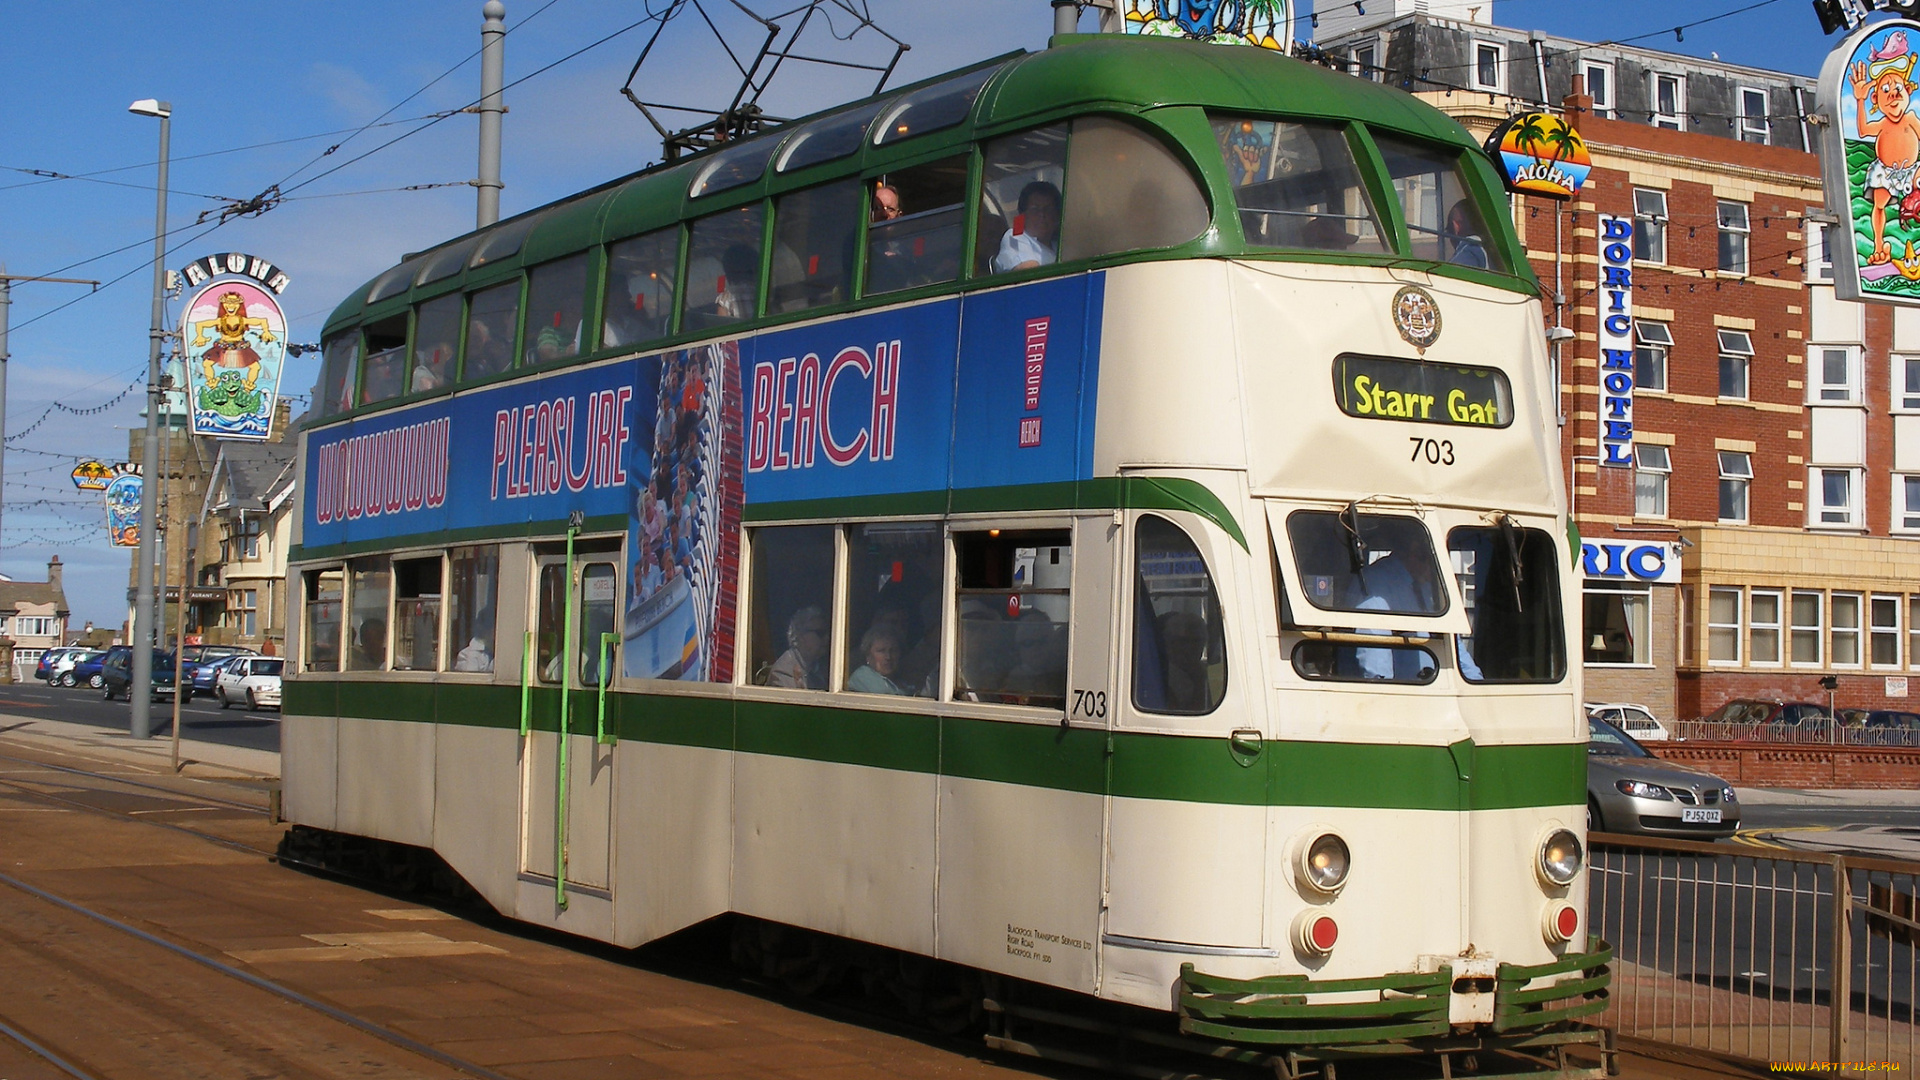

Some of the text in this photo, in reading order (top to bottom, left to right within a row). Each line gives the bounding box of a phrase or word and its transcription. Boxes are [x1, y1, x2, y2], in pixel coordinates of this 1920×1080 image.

[1514, 163, 1576, 193] ALOHA
[183, 252, 291, 296] ALOHA
[1602, 218, 1633, 338] DORIC
[1027, 321, 1049, 405] PLEASURE
[747, 339, 902, 473] BEACH
[1353, 374, 1435, 420] Starr
[1602, 348, 1633, 466] HOTEL
[490, 386, 634, 501] PLEASURE
[1020, 419, 1041, 444] BEACH
[1409, 437, 1456, 466] 703
[1073, 689, 1106, 718] 703
[1685, 811, 1719, 821] PJ52 OXZ
